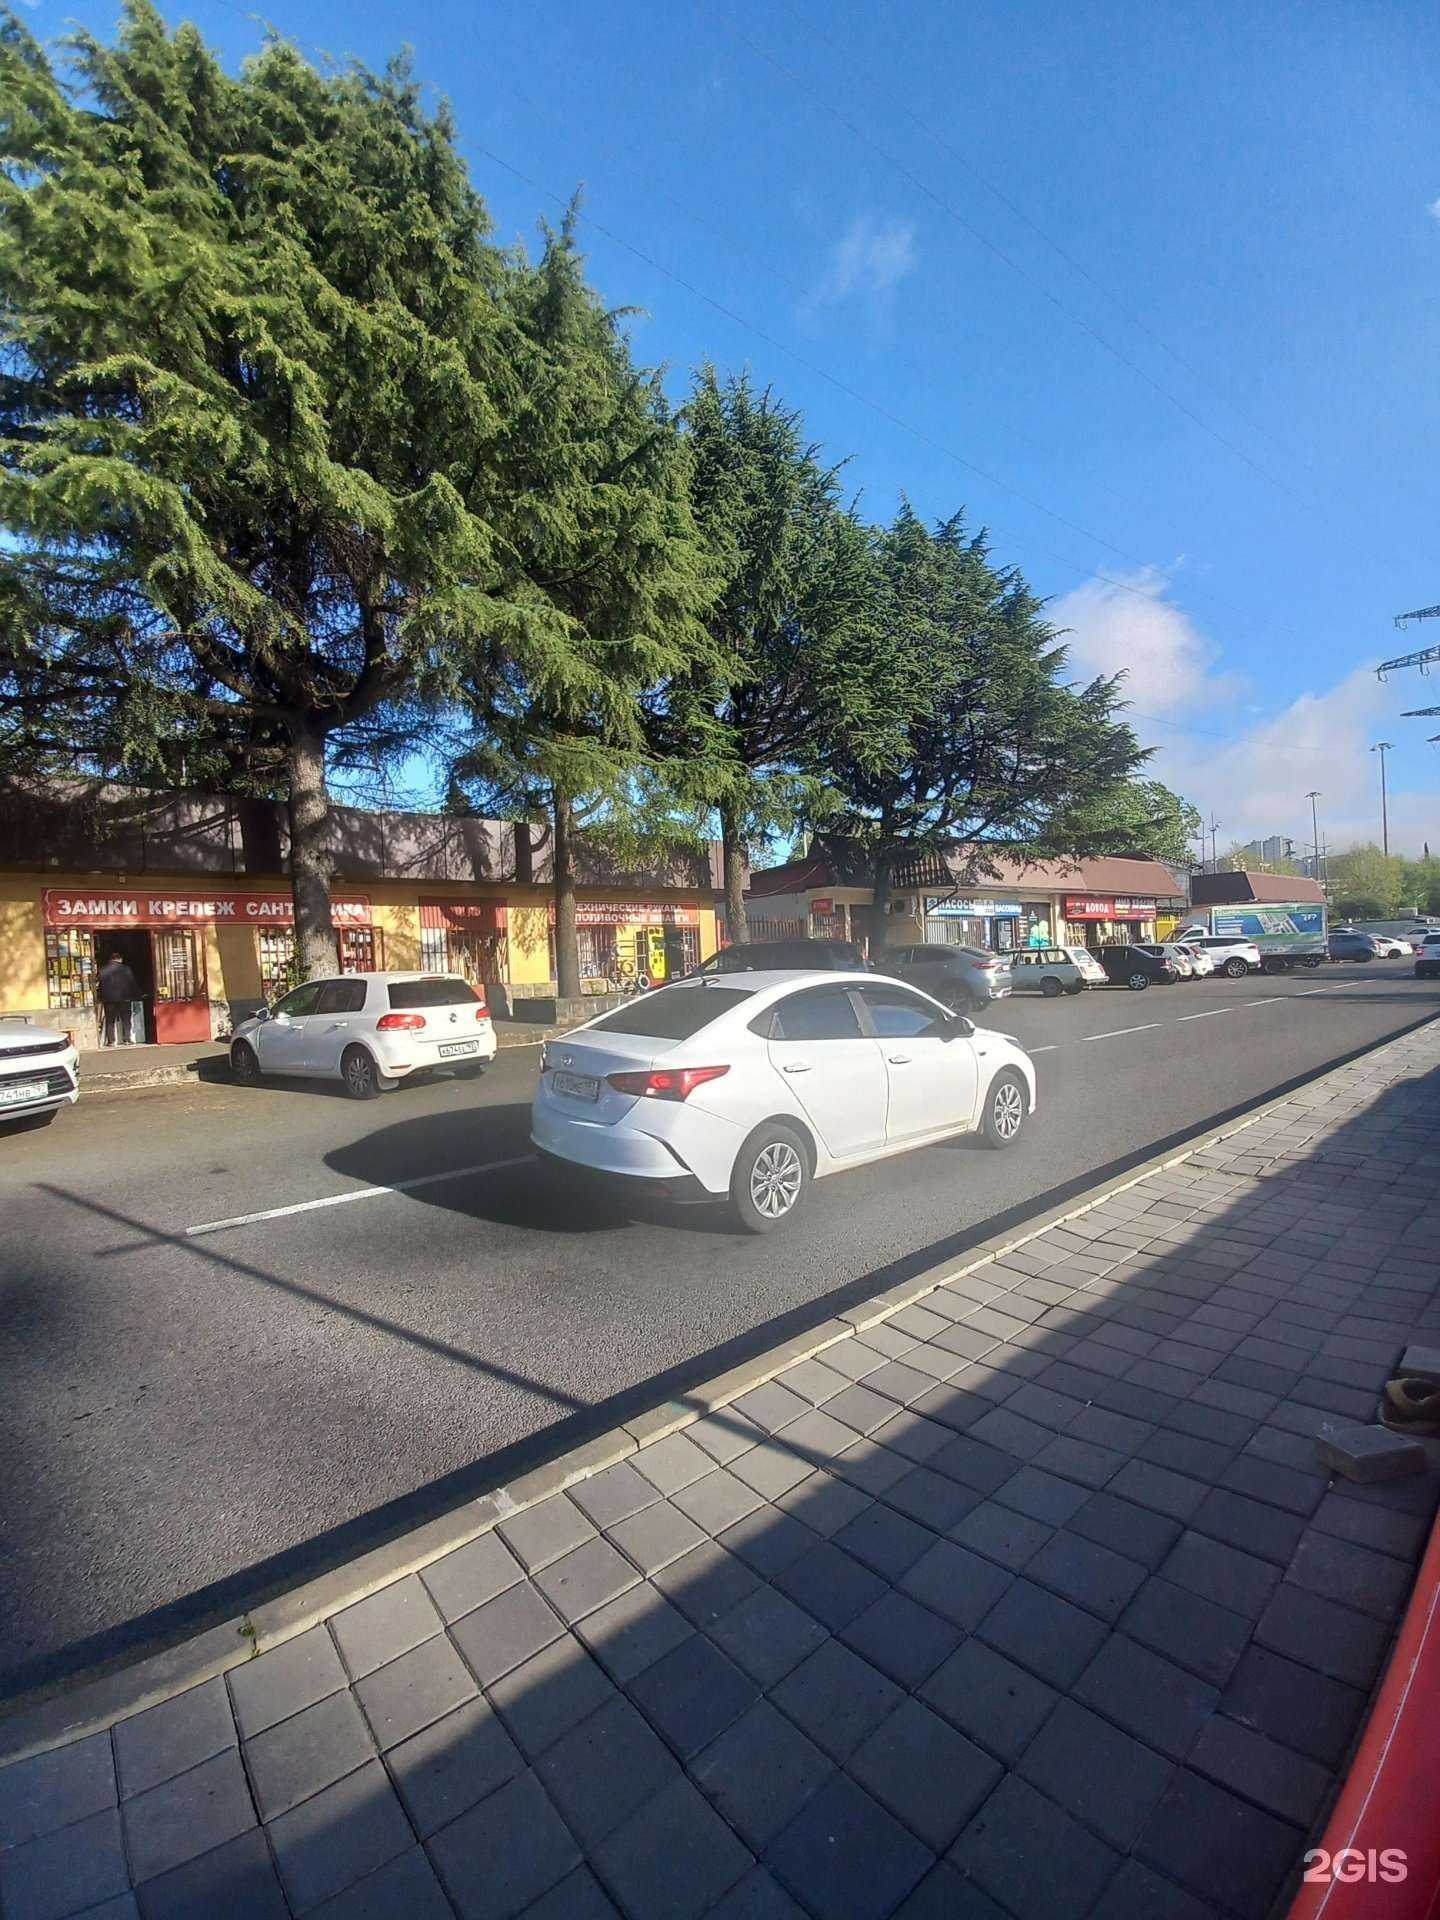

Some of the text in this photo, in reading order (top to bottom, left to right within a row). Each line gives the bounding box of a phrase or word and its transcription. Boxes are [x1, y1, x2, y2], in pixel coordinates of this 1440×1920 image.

[57, 899, 367, 917] ЗАМКИ КРЕПЕЖ САНТИКА
